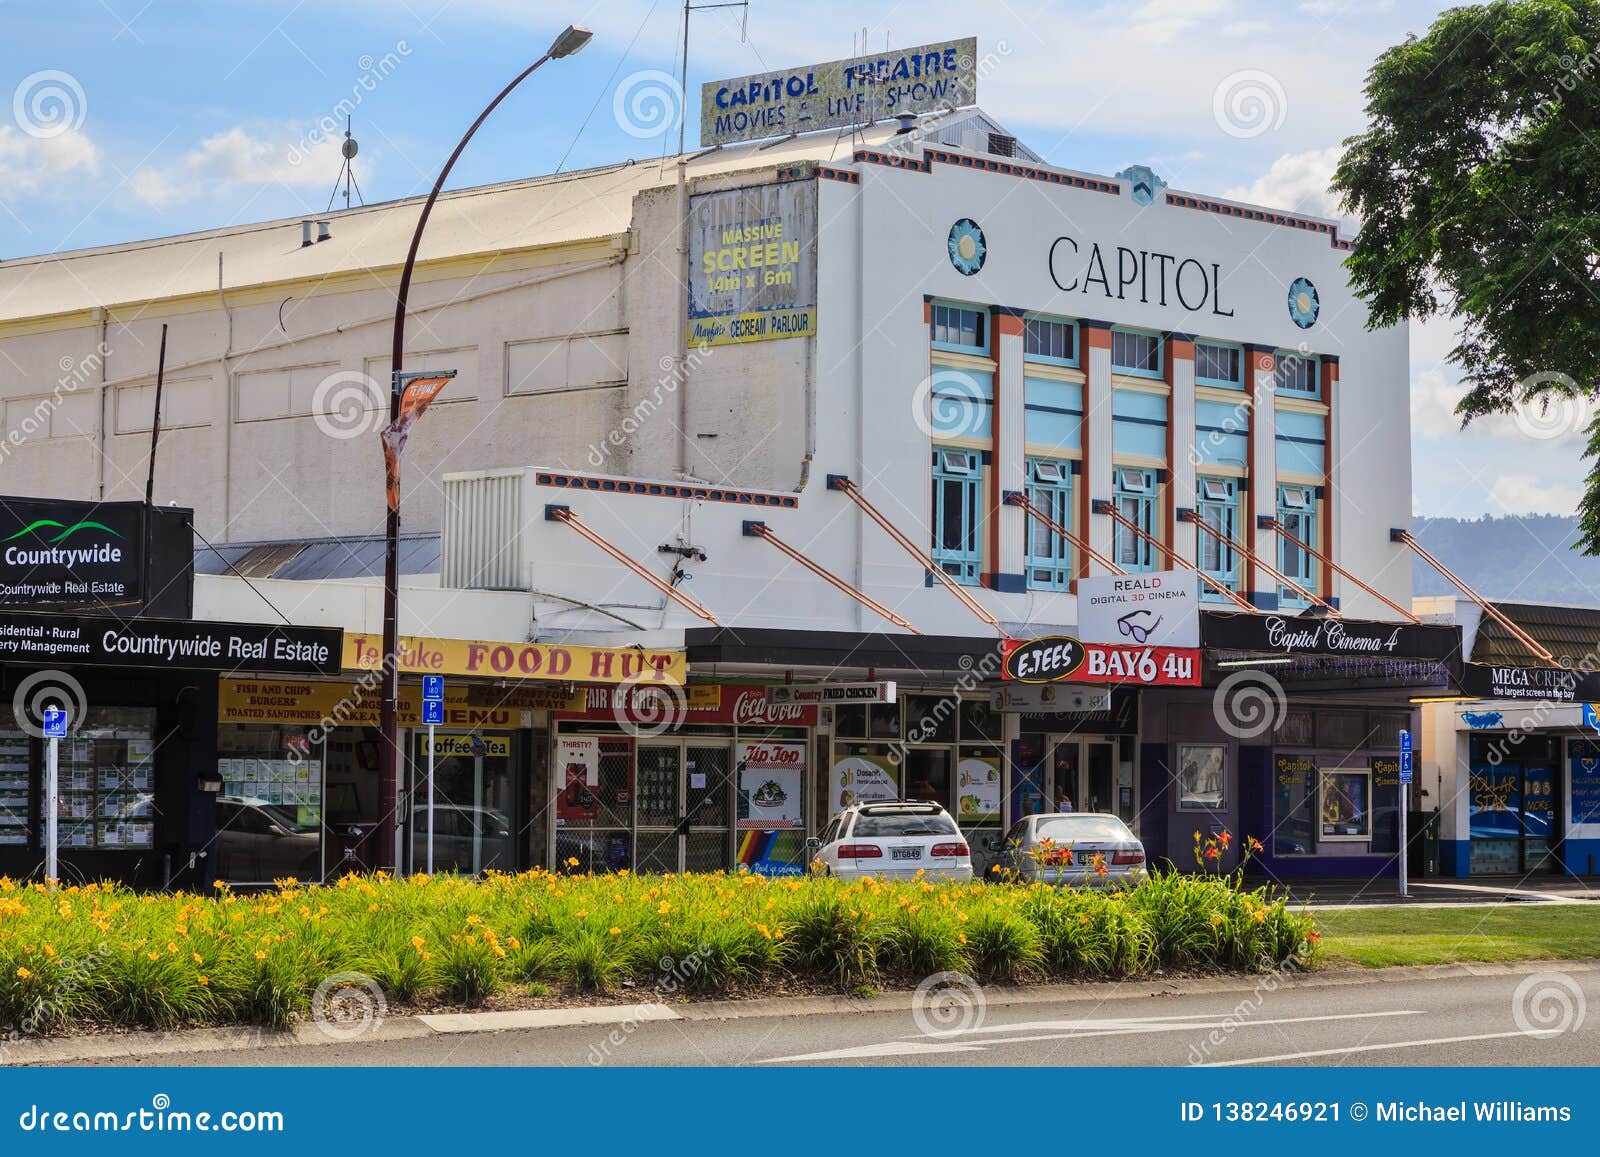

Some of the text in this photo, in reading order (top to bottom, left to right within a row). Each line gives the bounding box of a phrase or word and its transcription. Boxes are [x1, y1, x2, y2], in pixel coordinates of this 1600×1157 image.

[715, 73, 819, 109] CAPITOL
[716, 106, 785, 134] MOVIES
[722, 224, 783, 245] MASSIVE
[703, 240, 799, 274] SCREEN
[707, 275, 741, 293] 14m
[764, 270, 792, 286] 6m
[1049, 236, 1234, 317] CAPITOL
[771, 313, 809, 333] PARLOUR
[5, 543, 122, 568] Countrywide
[0, 581, 125, 597] Countrywide Real Estate
[1090, 590, 1186, 605] DIGITAL 3D CINEMA
[52, 627, 80, 639] Rural
[1265, 616, 1403, 652] Capitol Cinema 4
[20, 640, 90, 654] Management
[102, 630, 329, 664] Countrywide Real Estate
[353, 638, 672, 681] Te uke FOOD HUT
[1087, 648, 1158, 682] BAY6
[1162, 653, 1192, 680] 4u
[430, 677, 437, 686] P
[236, 685, 312, 695] FISH AND CHIPS
[793, 687, 878, 701] Country FRIED CHICKEN
[1493, 686, 1504, 695] the
[1504, 687, 1526, 698] largest
[1526, 688, 1545, 697] screen
[1546, 688, 1552, 697] in
[1563, 689, 1575, 700] bay
[249, 696, 296, 706] BURGERS
[430, 702, 437, 711] P
[51, 712, 59, 721] P
[226, 708, 321, 719] TOASTED SANDWICHES
[484, 739, 506, 754] Tea
[562, 741, 592, 749] THIRSTY?
[743, 745, 800, 763] Tip Top
[1278, 759, 1310, 772] Capitol
[1470, 775, 1518, 793] DOLLAR
[1475, 795, 1508, 812] STAR
